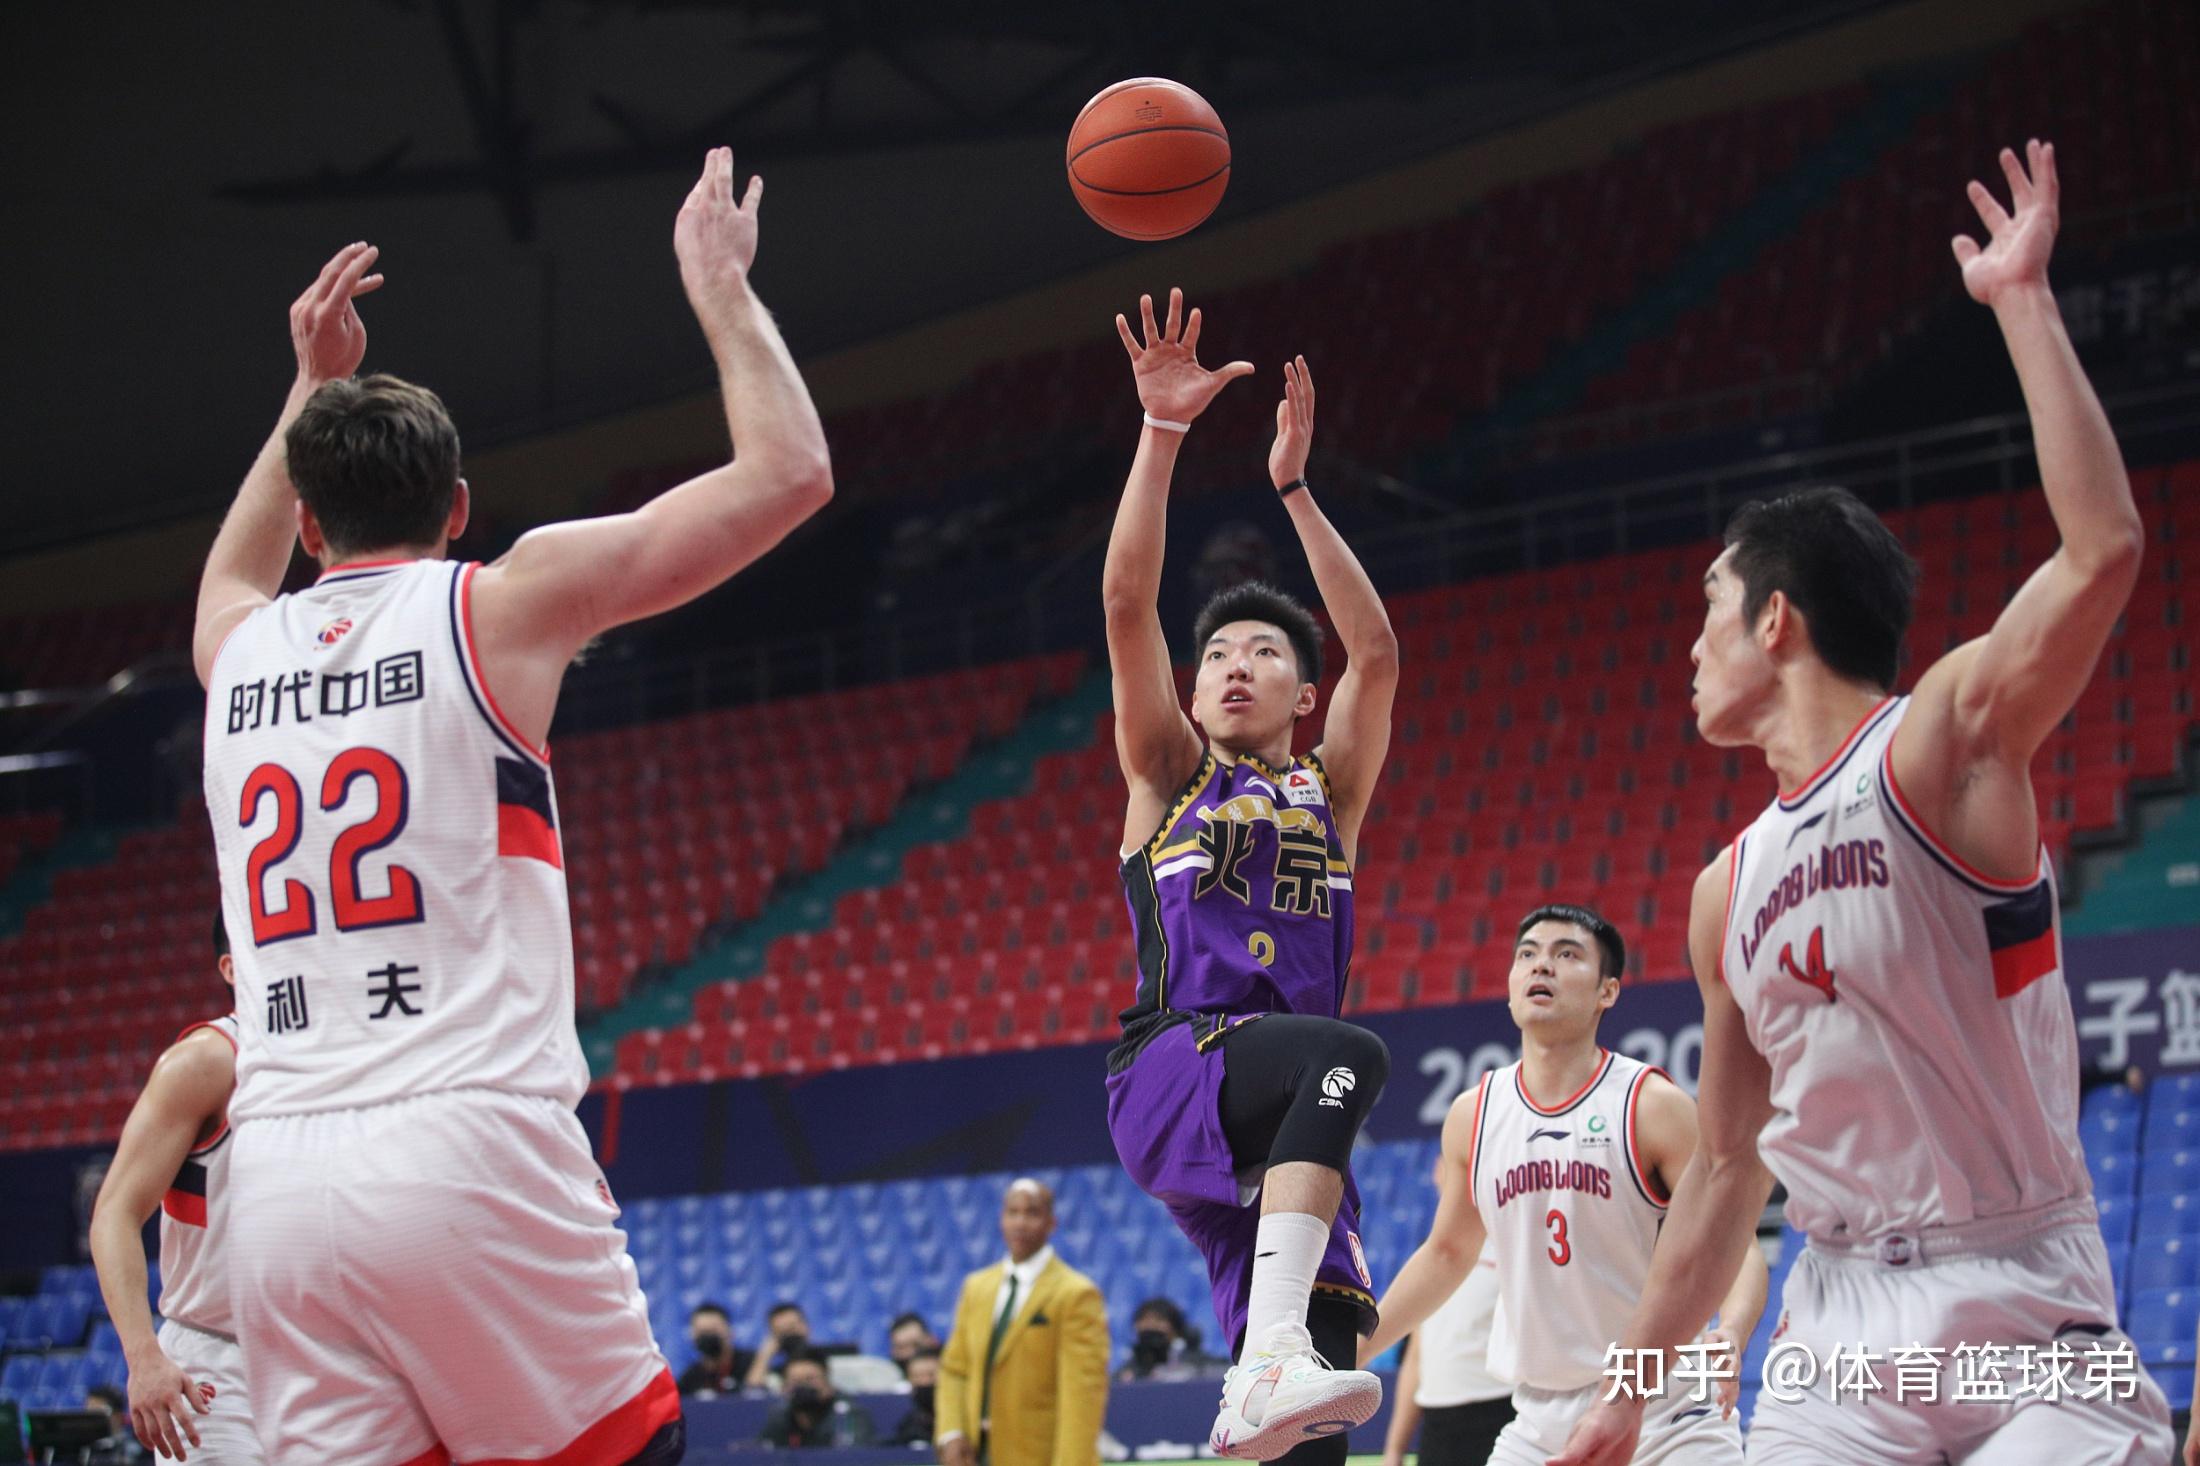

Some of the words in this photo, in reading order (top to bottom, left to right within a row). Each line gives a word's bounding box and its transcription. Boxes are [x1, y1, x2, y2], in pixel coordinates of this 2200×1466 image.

[227, 650, 424, 735] 时代中国
[239, 746, 425, 948] 22
[1194, 817, 1332, 919] 北京
[1318, 1097, 1345, 1110] CBA
[1495, 1159, 1553, 1209] LOONG
[1554, 1158, 1612, 1201] LIONS
[1546, 1208, 1571, 1267] 3
